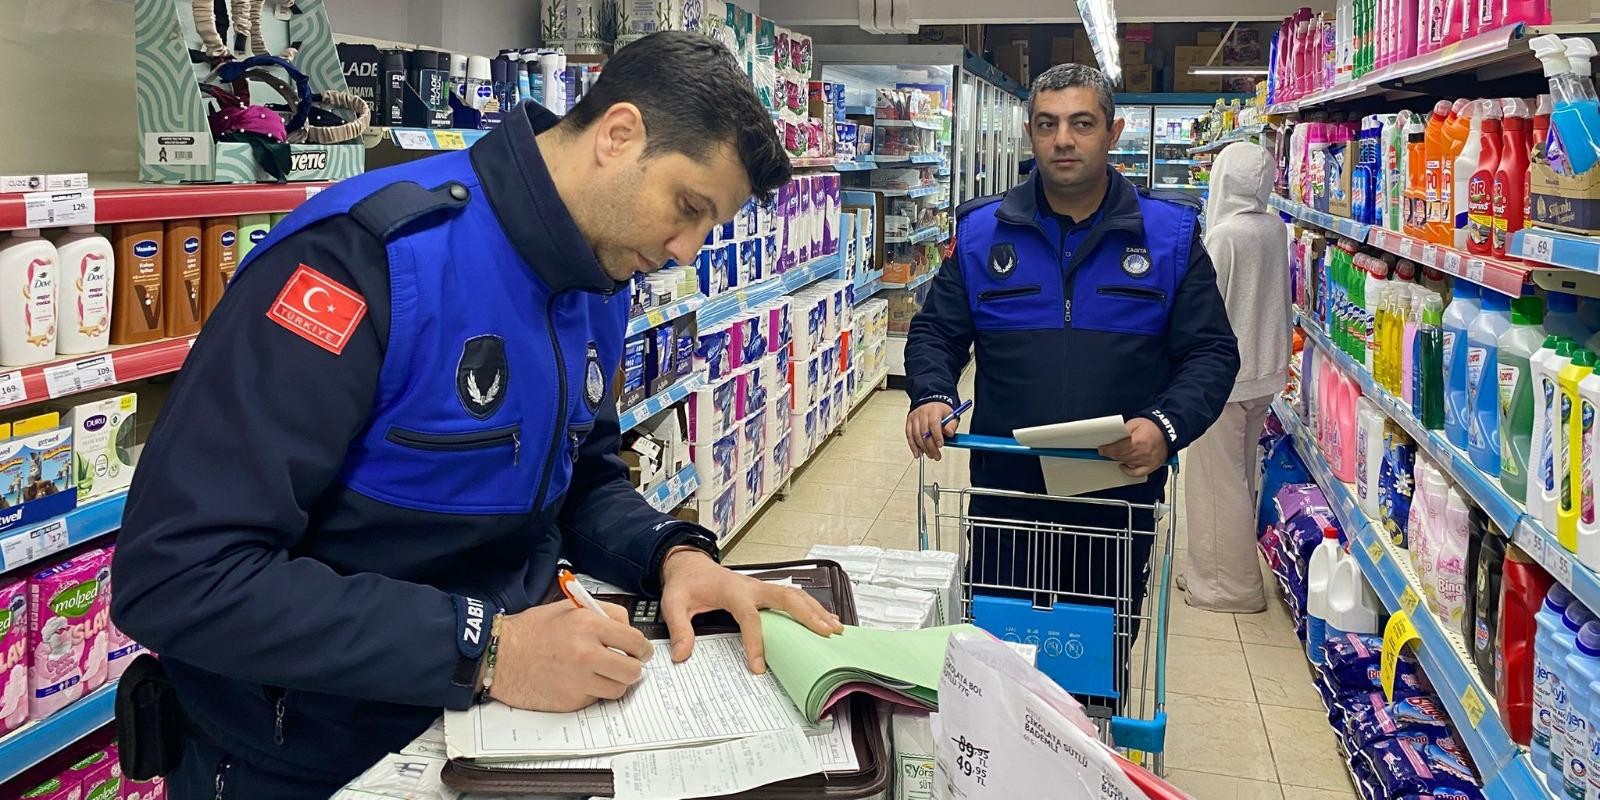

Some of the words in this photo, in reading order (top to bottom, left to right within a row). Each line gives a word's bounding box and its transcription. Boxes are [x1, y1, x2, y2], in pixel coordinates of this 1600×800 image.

[340, 62, 378, 77] LADE
[1537, 241, 1548, 255] 69
[35, 280, 52, 289] Dove
[88, 273, 104, 282] Dove
[280, 307, 334, 342] TÜRKİYE
[86, 417, 106, 428] DURU
[1151, 409, 1178, 443] ZABITA
[1438, 577, 1465, 595] Bing
[55, 580, 98, 613] molped
[463, 596, 484, 645] ZABIT
